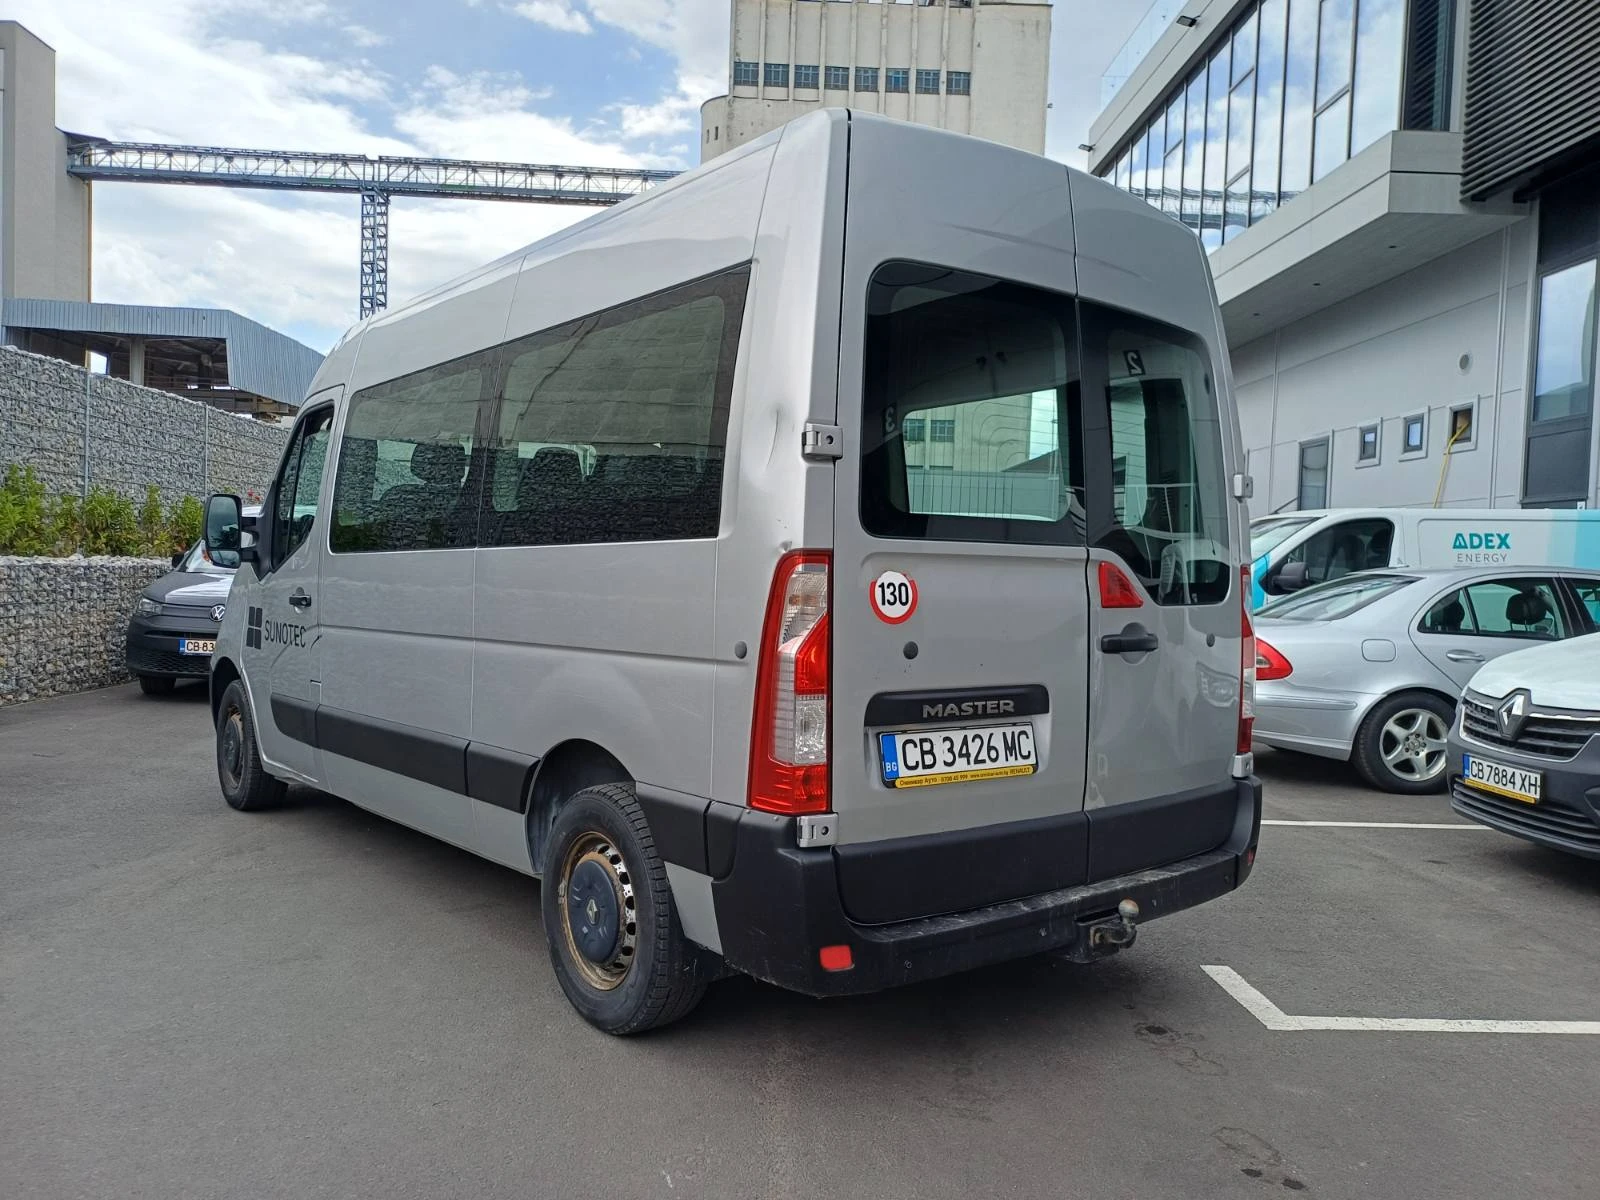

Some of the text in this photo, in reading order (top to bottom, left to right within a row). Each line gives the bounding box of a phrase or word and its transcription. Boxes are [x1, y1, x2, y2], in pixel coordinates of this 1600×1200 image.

[1452, 532, 1511, 550] ADEX
[1457, 553, 1507, 563] ENERGY
[878, 581, 909, 607] 130
[264, 619, 307, 648] SUNOTEC
[186, 641, 200, 652] CB
[922, 700, 1015, 719] MASTER
[901, 729, 1032, 771] CB 3426 MC
[885, 763, 898, 772] BG
[1470, 760, 1485, 780] CB
[1486, 764, 1516, 790] 7884
[1519, 772, 1538, 795] XH
